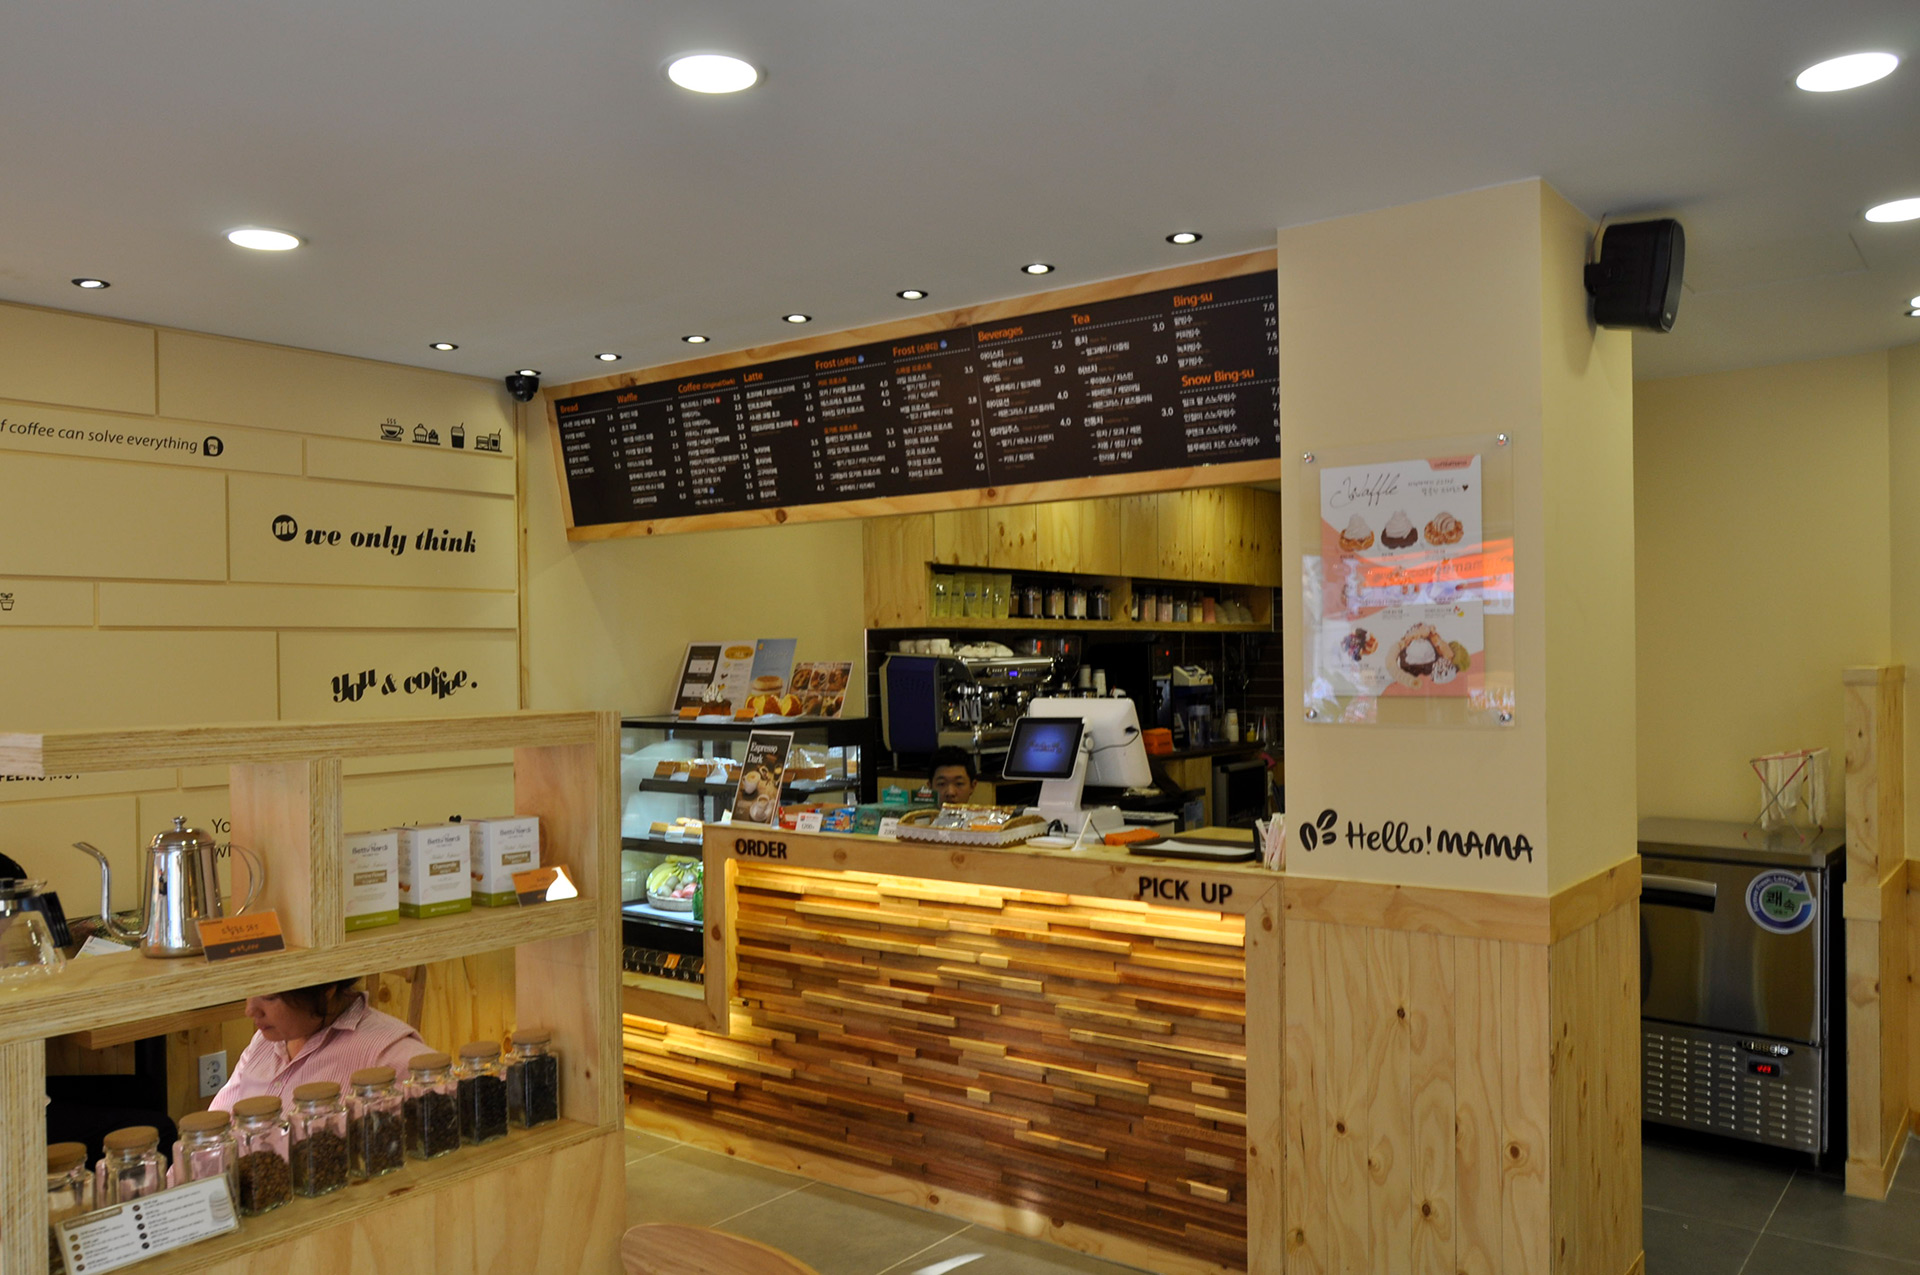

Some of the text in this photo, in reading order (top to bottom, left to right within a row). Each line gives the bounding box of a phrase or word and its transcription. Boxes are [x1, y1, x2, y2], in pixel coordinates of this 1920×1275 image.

[1173, 292, 1213, 308] Bing-su
[1072, 313, 1090, 325] Tea
[978, 326, 1023, 341] Beverages
[893, 345, 915, 357] Frost
[816, 359, 836, 370] Frost
[744, 373, 763, 382] Latte
[1182, 368, 1254, 387] Snow Bing-su
[678, 382, 701, 394] Coffee
[9, 422, 55, 438] coffee
[58, 428, 84, 440] can
[88, 430, 124, 444] solve
[126, 435, 198, 454] everything
[1330, 474, 1400, 508] Waffle
[304, 528, 342, 546] we
[350, 526, 407, 556] only
[415, 528, 476, 553] think
[331, 669, 377, 703] you
[381, 674, 397, 695] &
[750, 741, 778, 754] Espresso
[748, 753, 763, 764] Dark
[735, 838, 788, 860] ORDER
[1138, 876, 1232, 905] PICK UP
